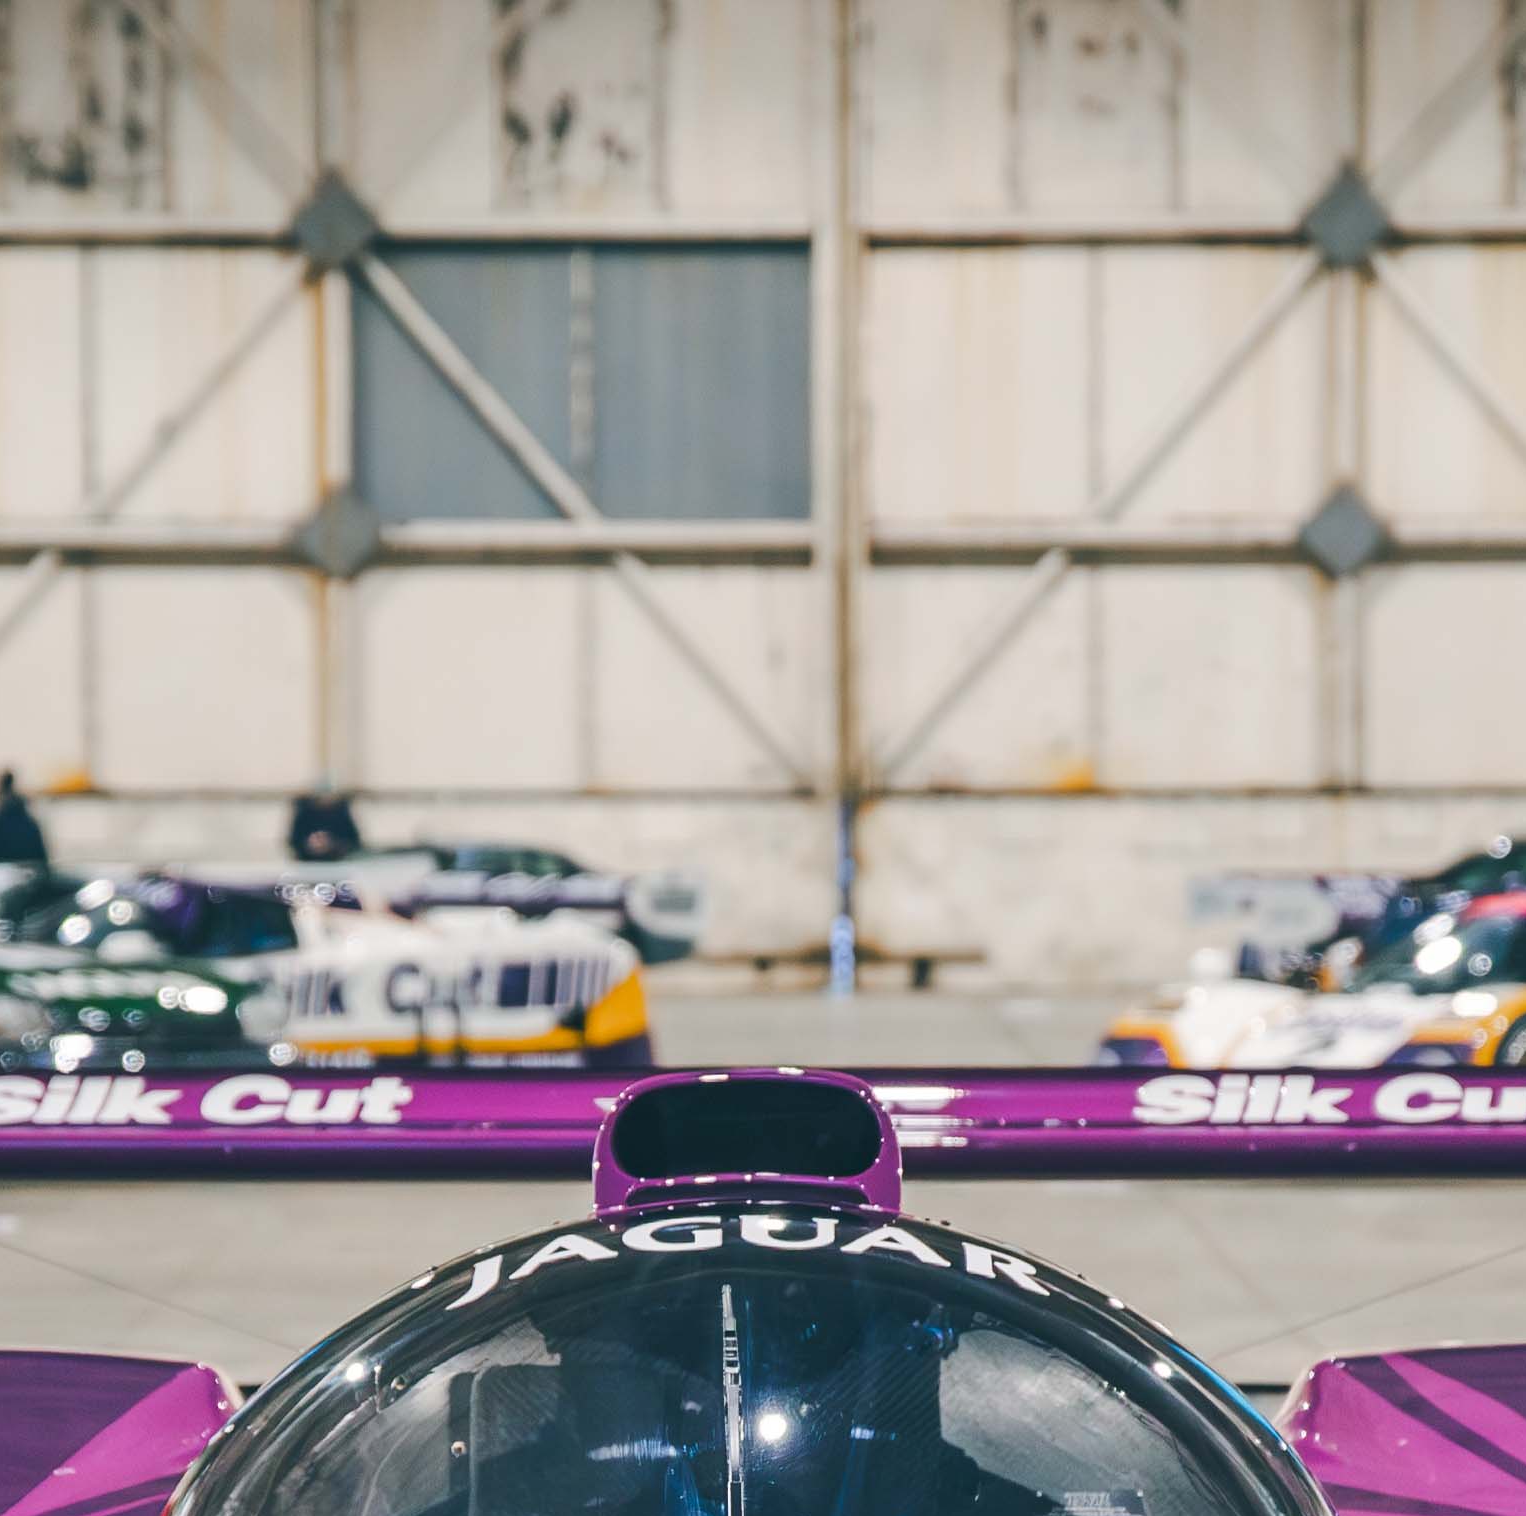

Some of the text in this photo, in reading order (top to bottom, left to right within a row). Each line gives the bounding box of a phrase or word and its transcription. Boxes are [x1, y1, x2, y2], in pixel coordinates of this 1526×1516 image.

[199, 1074, 413, 1125] Cut
[1133, 1074, 1351, 1125] Silk
[444, 1214, 1052, 1311] JAGUAR
